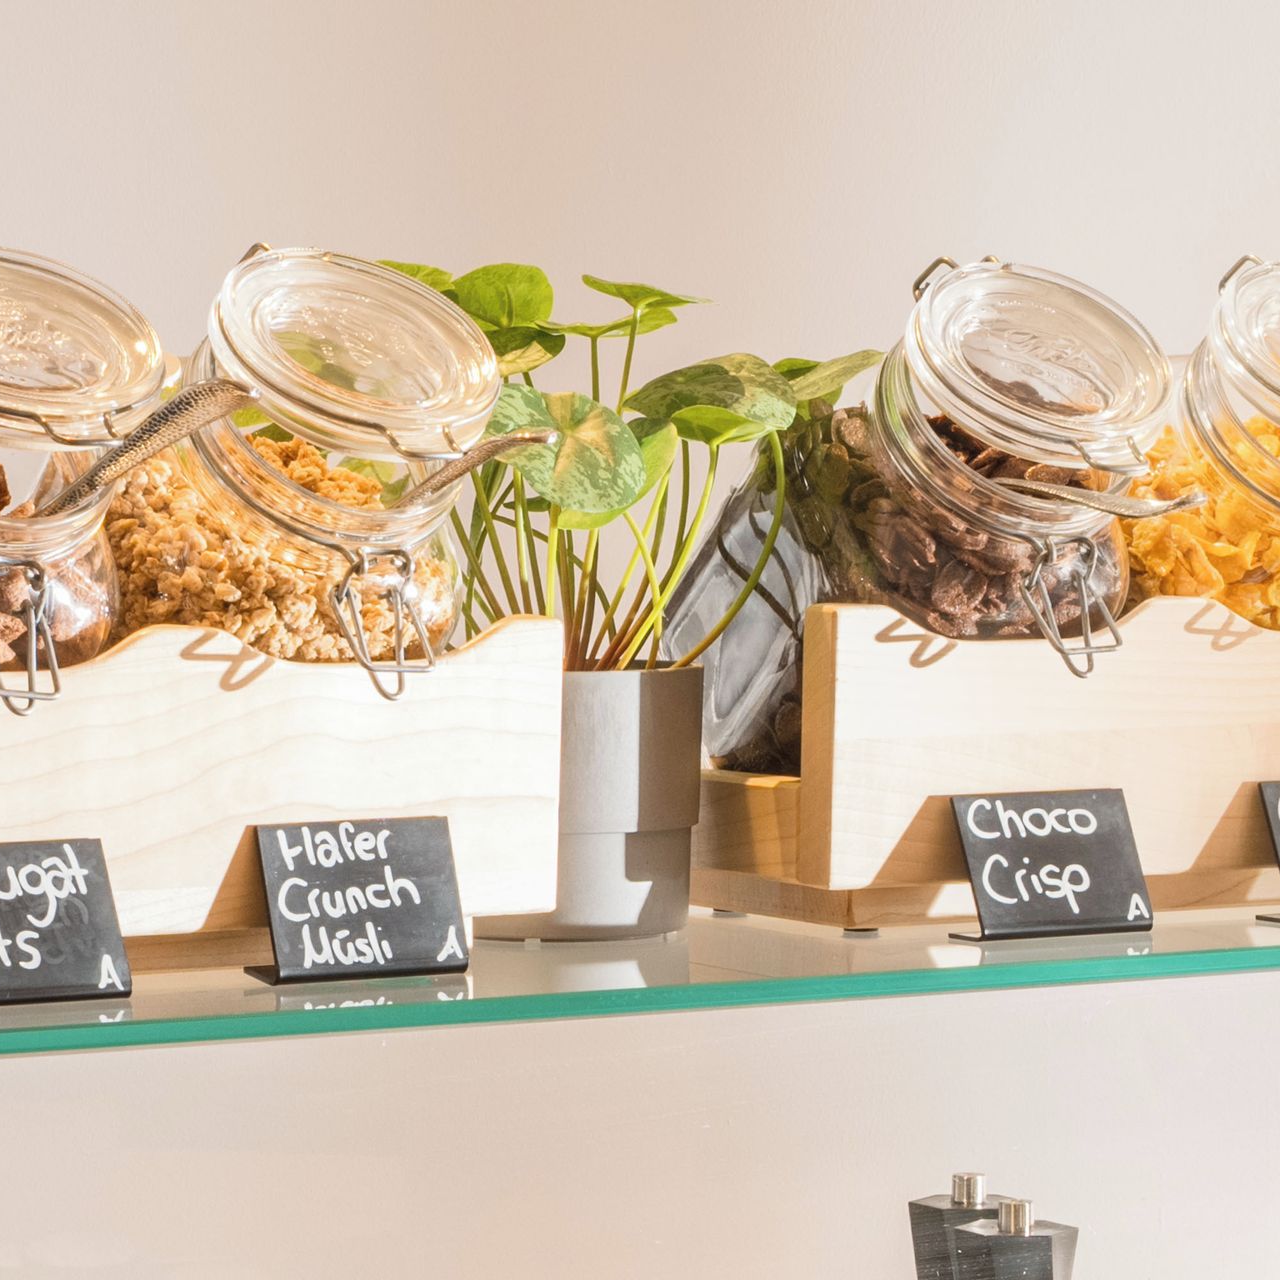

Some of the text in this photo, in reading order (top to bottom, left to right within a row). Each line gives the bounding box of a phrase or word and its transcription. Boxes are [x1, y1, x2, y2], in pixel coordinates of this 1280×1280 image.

[967, 799, 1097, 839] Choco
[277, 822, 390, 871] Hafer
[278, 865, 421, 922] Crunch
[982, 854, 1090, 914] Crisp
[1127, 893, 1150, 921] A
[302, 922, 393, 969] Müsli
[437, 925, 464, 962] A
[98, 954, 124, 990] A
